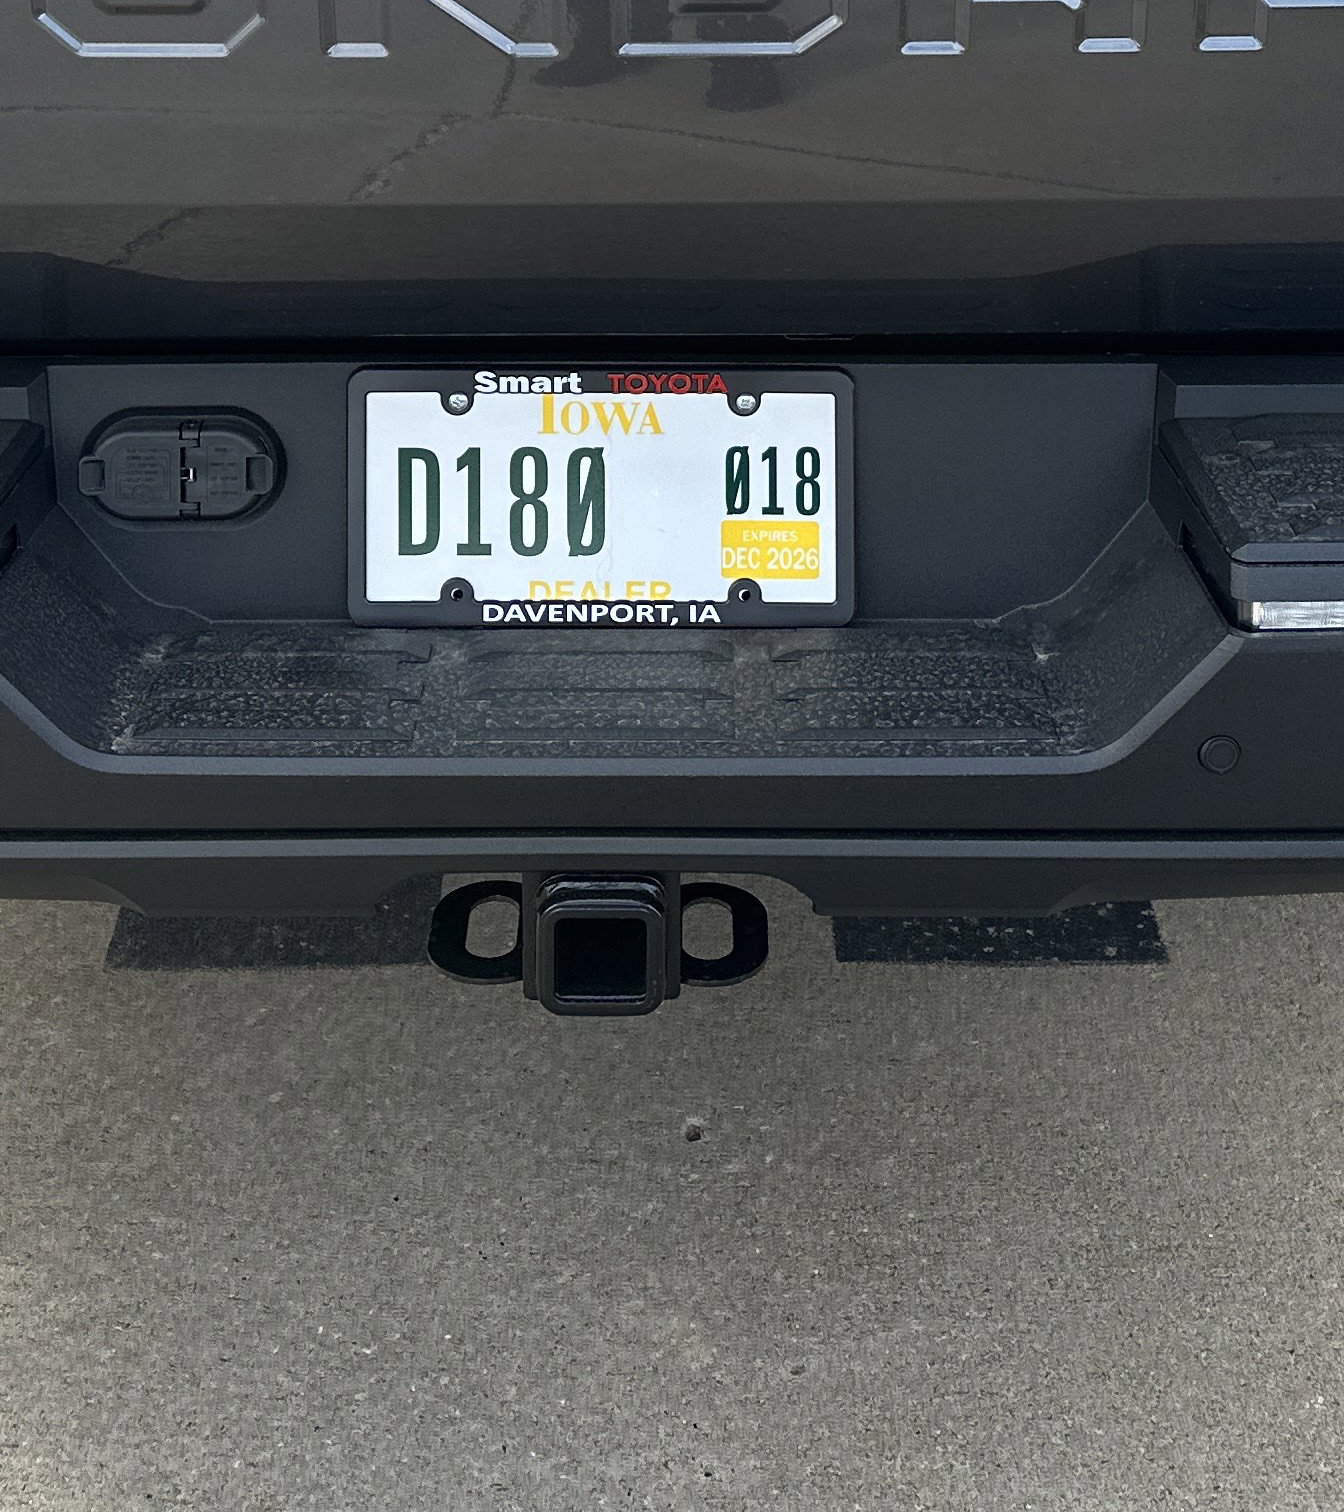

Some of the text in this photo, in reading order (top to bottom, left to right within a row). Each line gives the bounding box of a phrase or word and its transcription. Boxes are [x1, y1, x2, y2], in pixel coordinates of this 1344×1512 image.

[474, 370, 729, 395] Smart TOYOTA
[398, 445, 821, 557] D180 018
[741, 530, 799, 543] EXPIRES
[722, 546, 820, 571] DEC 2026
[482, 603, 722, 627] DAVENPORT, IA
